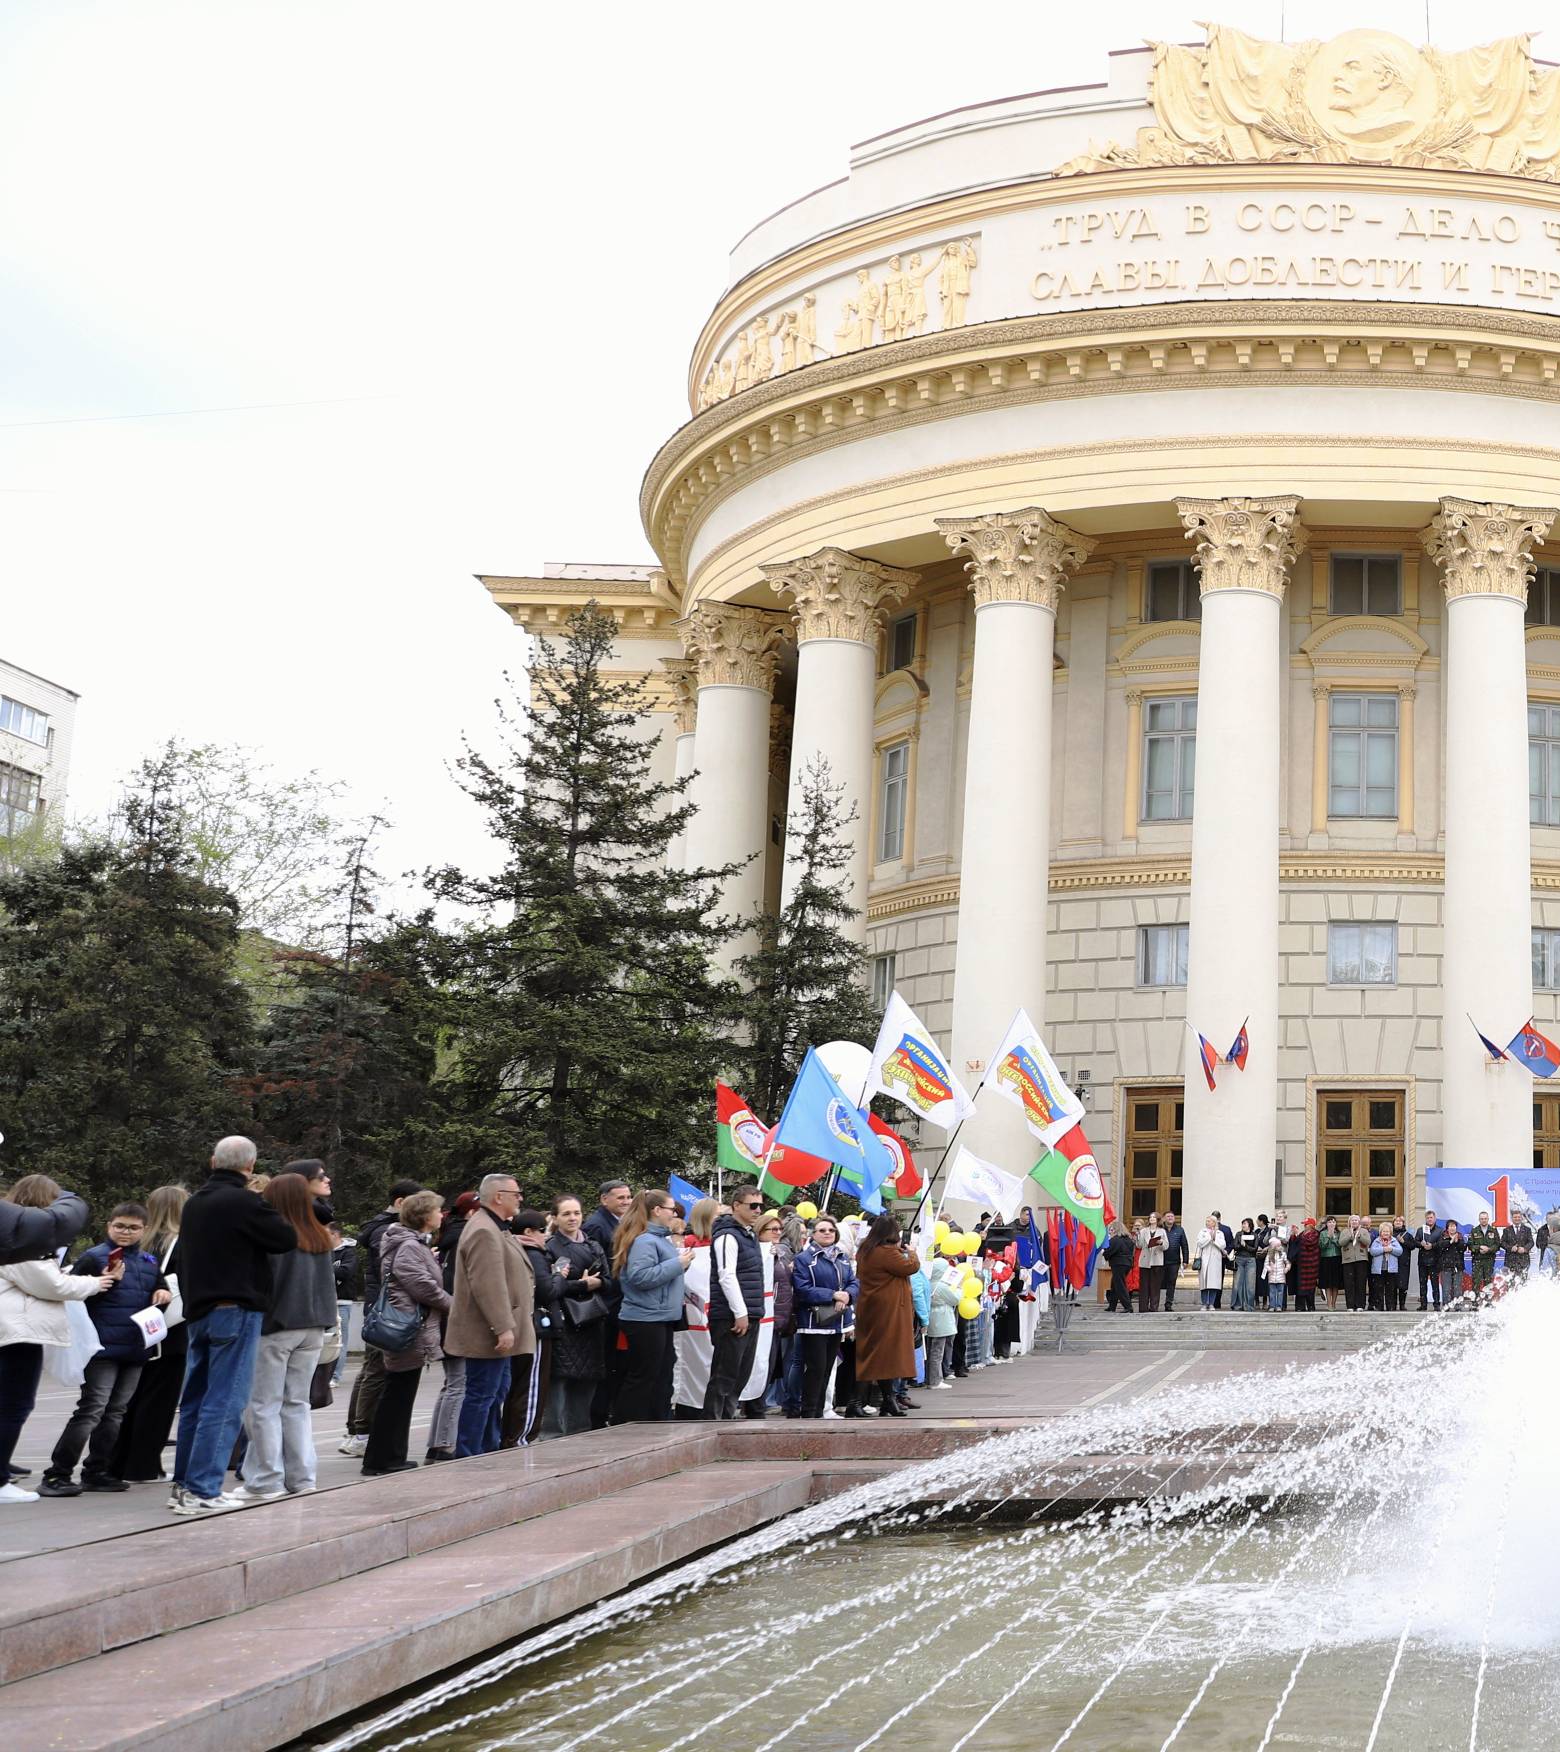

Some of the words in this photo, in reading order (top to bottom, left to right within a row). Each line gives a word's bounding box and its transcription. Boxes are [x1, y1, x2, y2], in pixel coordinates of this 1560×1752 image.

[1185, 204, 1212, 234] В
[1396, 206, 1521, 243] ДЕЛО
[1195, 255, 1422, 291] ДОБЛЕСТИ
[1441, 261, 1470, 291] И
[1487, 1174, 1511, 1228] 1
